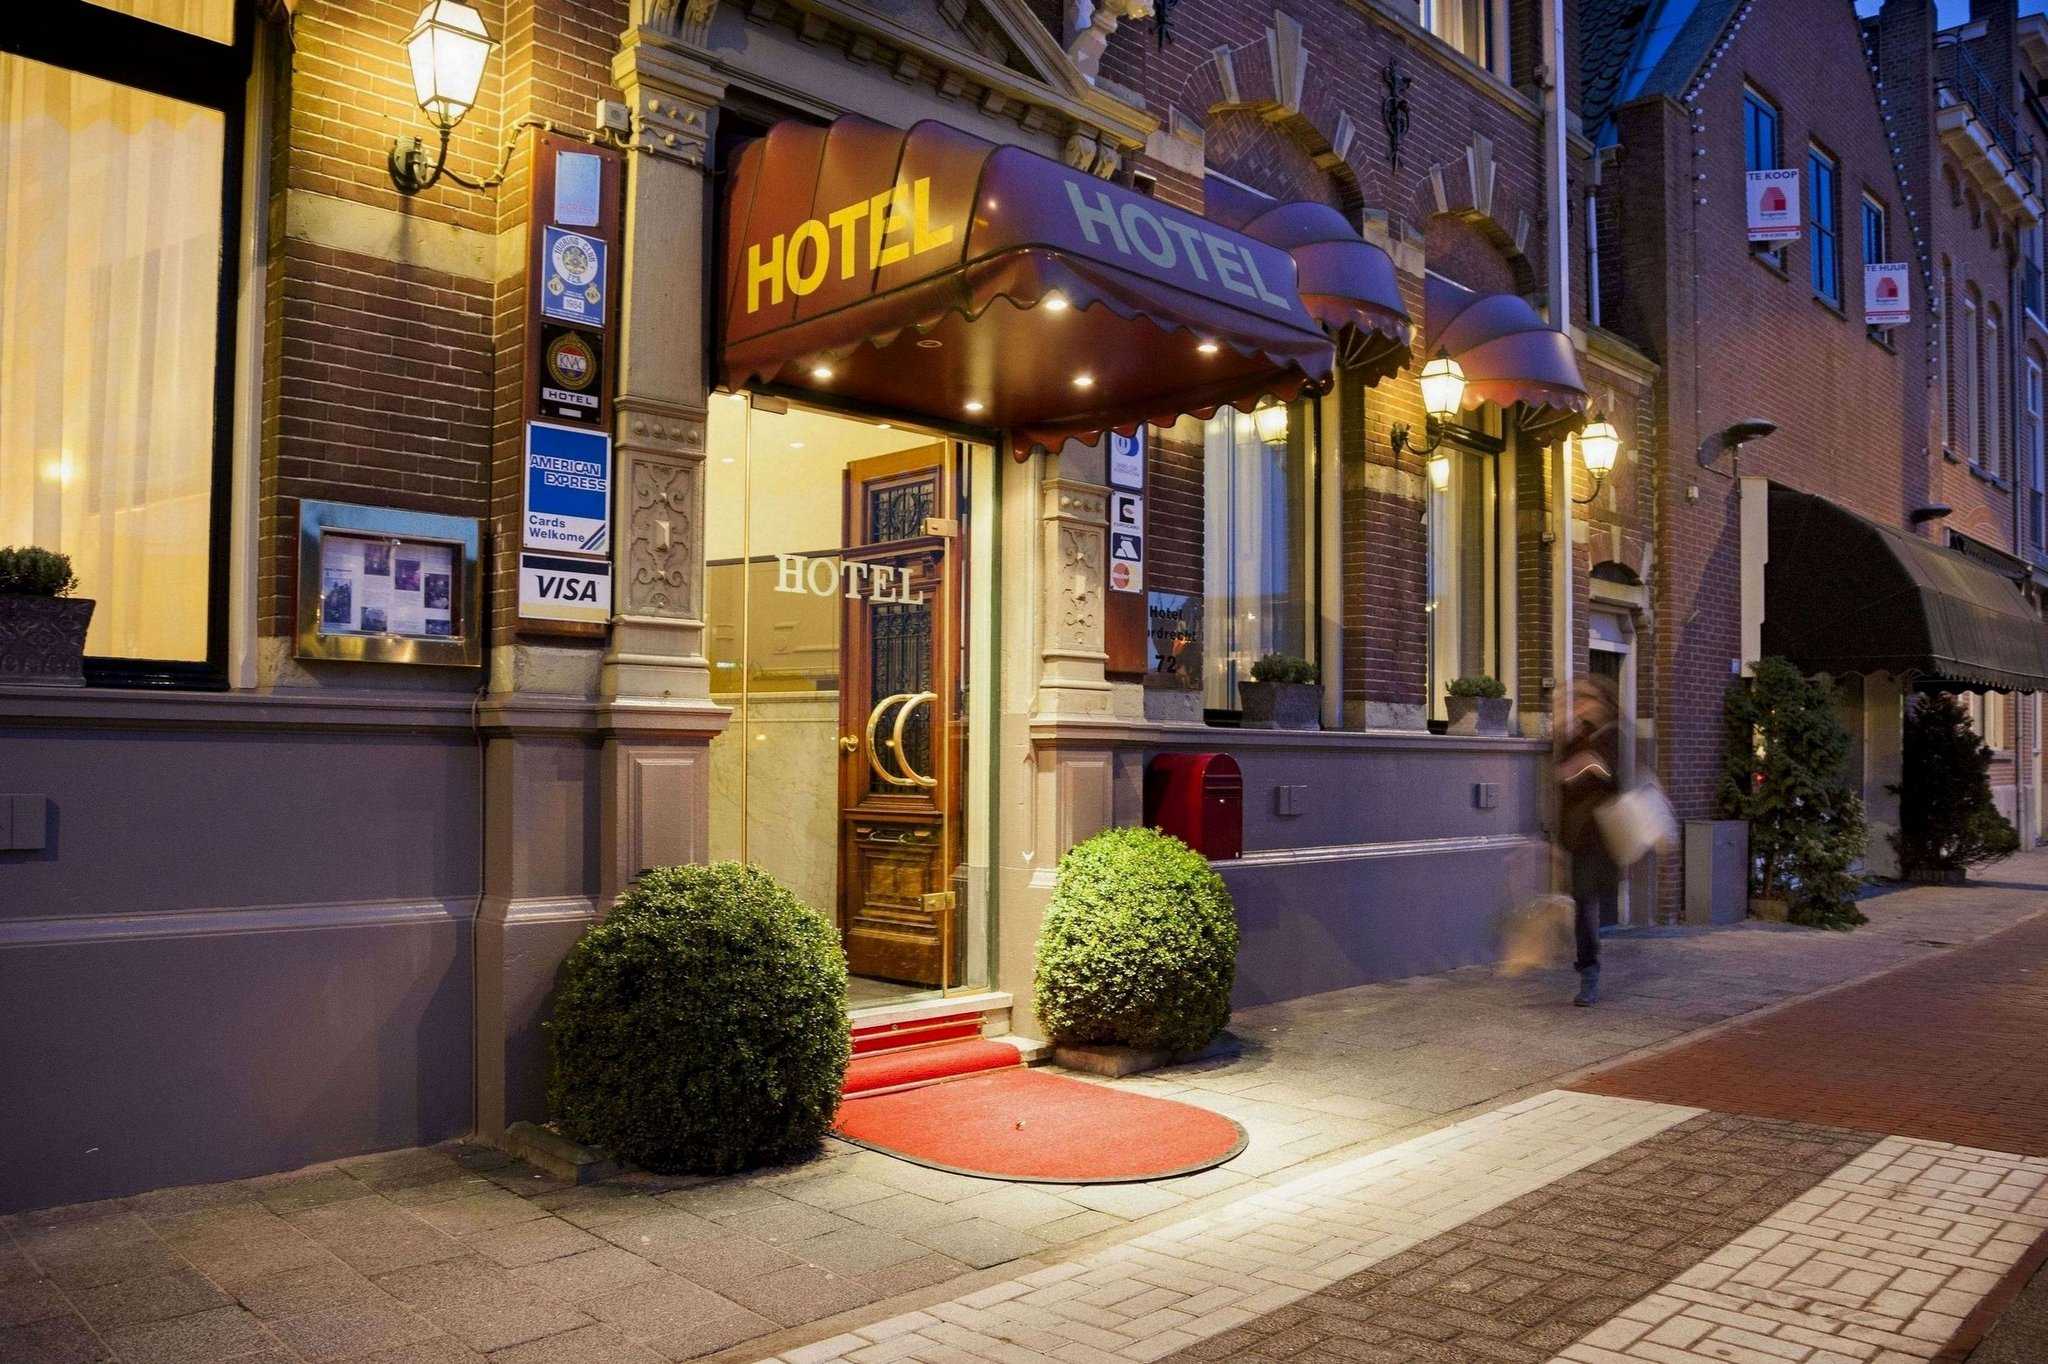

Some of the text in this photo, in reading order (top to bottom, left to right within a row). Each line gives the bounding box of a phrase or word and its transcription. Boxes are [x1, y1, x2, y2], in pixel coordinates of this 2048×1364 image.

[1748, 171, 1798, 181] TE KOOP
[748, 177, 954, 314] HOTEL
[1064, 180, 1291, 310] HOTEL
[1880, 264, 1907, 272] HUUR
[548, 390, 592, 405] HOTEL
[530, 455, 600, 476] AMERICAN
[544, 473, 607, 491] EXPRESS
[529, 515, 566, 528] Cards
[529, 527, 585, 543] Welkome
[774, 553, 924, 605] HOTEL
[536, 575, 598, 602] VISA
[1150, 606, 1183, 620] Hotel
[1155, 655, 1176, 673] 72
